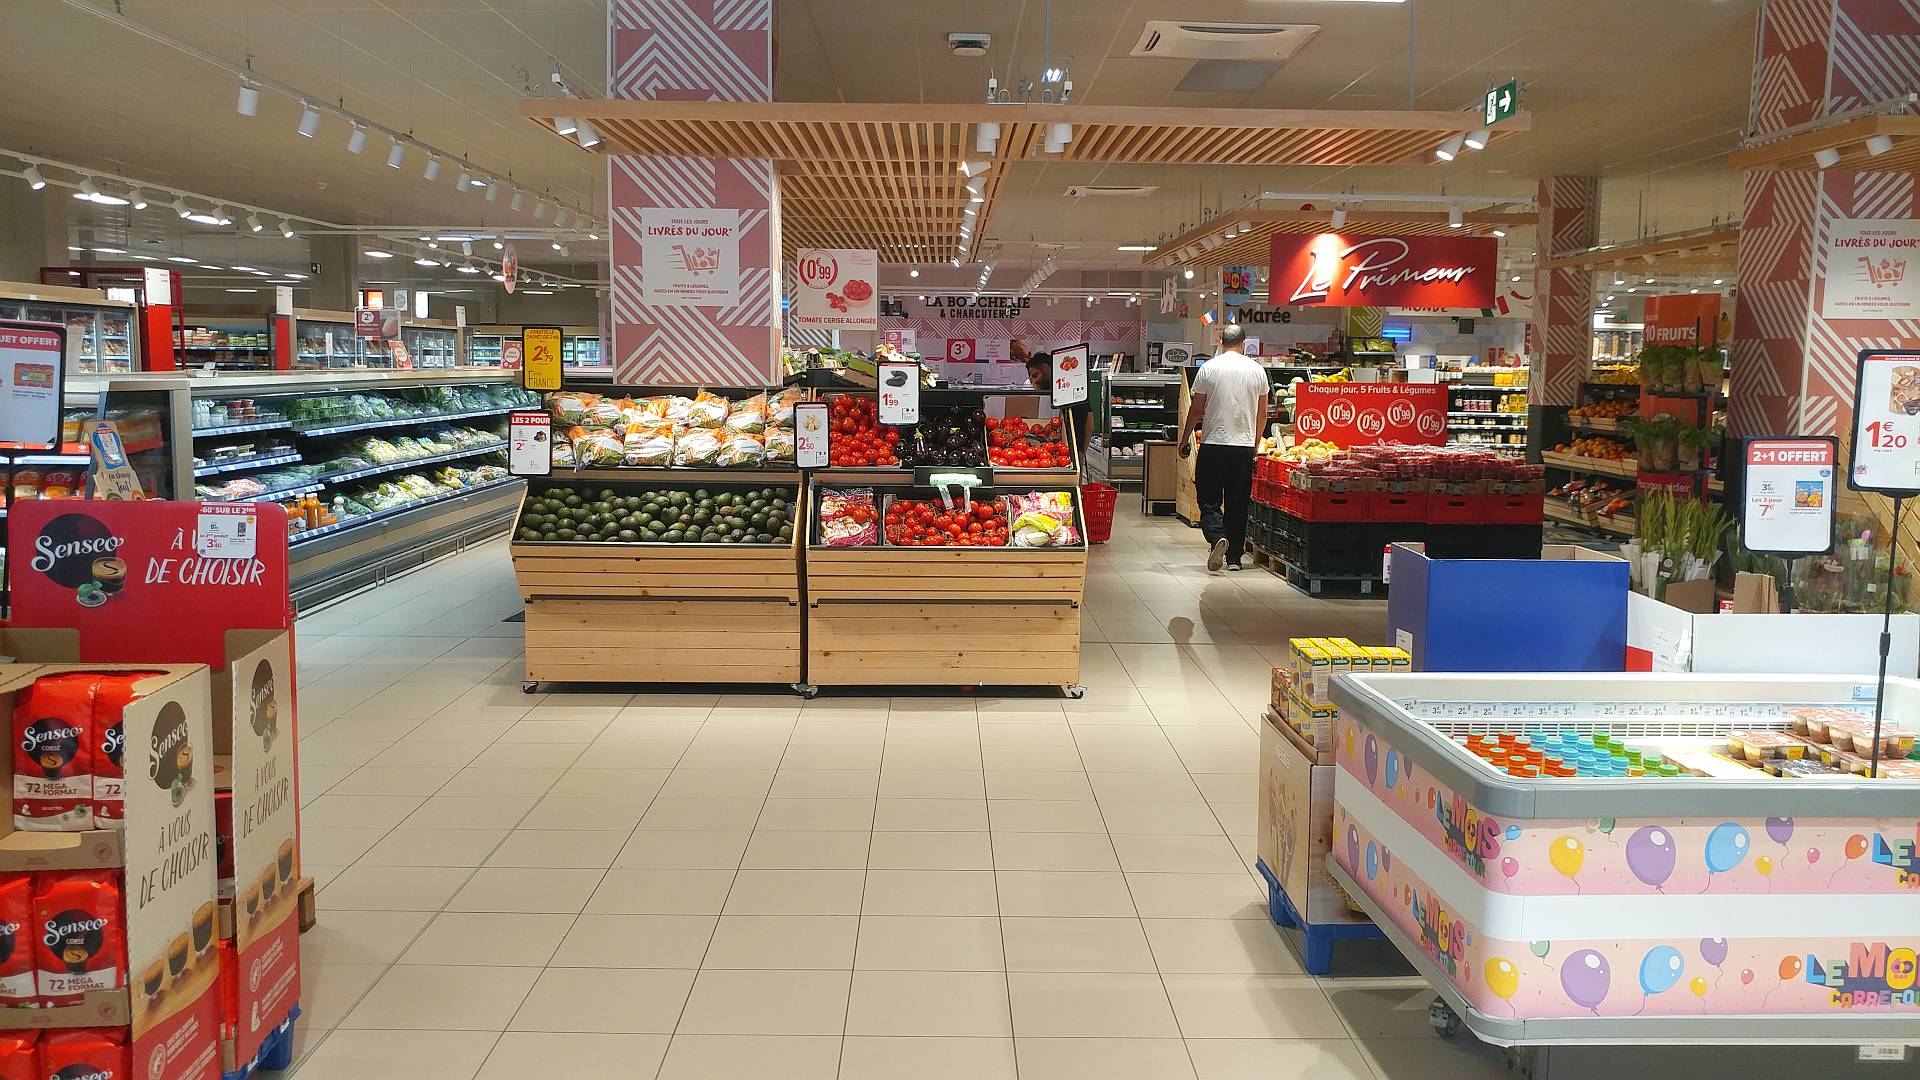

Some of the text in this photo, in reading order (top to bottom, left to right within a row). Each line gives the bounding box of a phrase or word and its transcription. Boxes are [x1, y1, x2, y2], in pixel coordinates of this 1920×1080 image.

[648, 225, 683, 236] LIVRÉS
[686, 227, 698, 236] DU
[1834, 236, 1871, 248] LIVRÉS
[1873, 238, 1887, 248] DU
[1339, 238, 1476, 290] Primeur
[926, 296, 943, 307] LA
[799, 316, 822, 324] TOMATE
[845, 316, 876, 325] ALLONGÉE
[940, 308, 946, 318] &
[1238, 307, 1291, 323] Marée
[19, 335, 59, 347] OFFERT
[1656, 326, 1697, 341] FRUITS
[1308, 385, 1339, 395] Chaque
[1360, 386, 1366, 394] 5
[1368, 386, 1391, 394] Fruits
[1392, 386, 1399, 394] &
[1400, 385, 1437, 396] Légumes
[530, 417, 551, 425] POUR
[1865, 421, 1907, 449] 1€20
[1752, 450, 1828, 462] 2+1 OFFERT
[215, 506, 230, 514] SUR
[231, 506, 241, 514] LE
[171, 526, 185, 550] À
[31, 535, 125, 572] Senseo
[144, 557, 267, 587] DE CHOISIR
[21, 726, 84, 752] Senseo
[148, 719, 189, 780] Senseo
[26, 782, 42, 794] 72
[43, 788, 79, 796] FORMAT
[105, 784, 121, 795] 72
[1435, 790, 1452, 830] LE
[168, 808, 192, 848] VOUS
[1872, 832, 1913, 867] LE
[139, 831, 210, 911] DE CHOISIR
[1412, 887, 1427, 929] LE
[43, 918, 109, 946] Senseo
[1805, 953, 1845, 986] LE
[49, 977, 94, 990] 72 MEGA
[68, 983, 105, 992] FORMAT
